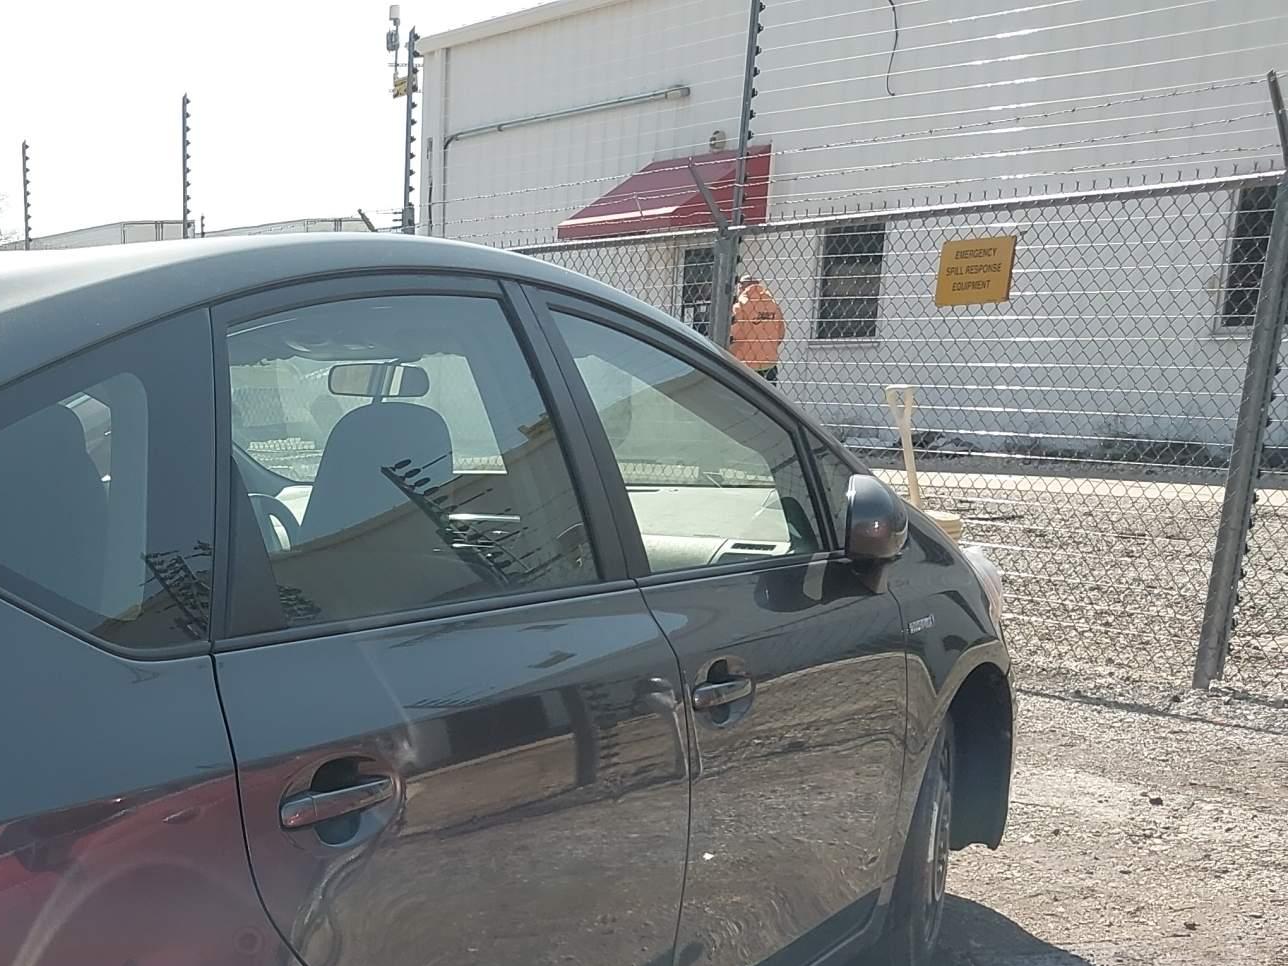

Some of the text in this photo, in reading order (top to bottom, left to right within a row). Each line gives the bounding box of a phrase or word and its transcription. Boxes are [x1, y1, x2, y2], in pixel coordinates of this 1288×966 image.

[955, 248, 998, 260] EMERGENCY
[946, 263, 1002, 276] SPILL RESPONSE
[952, 280, 991, 291] EQUIPMENT
